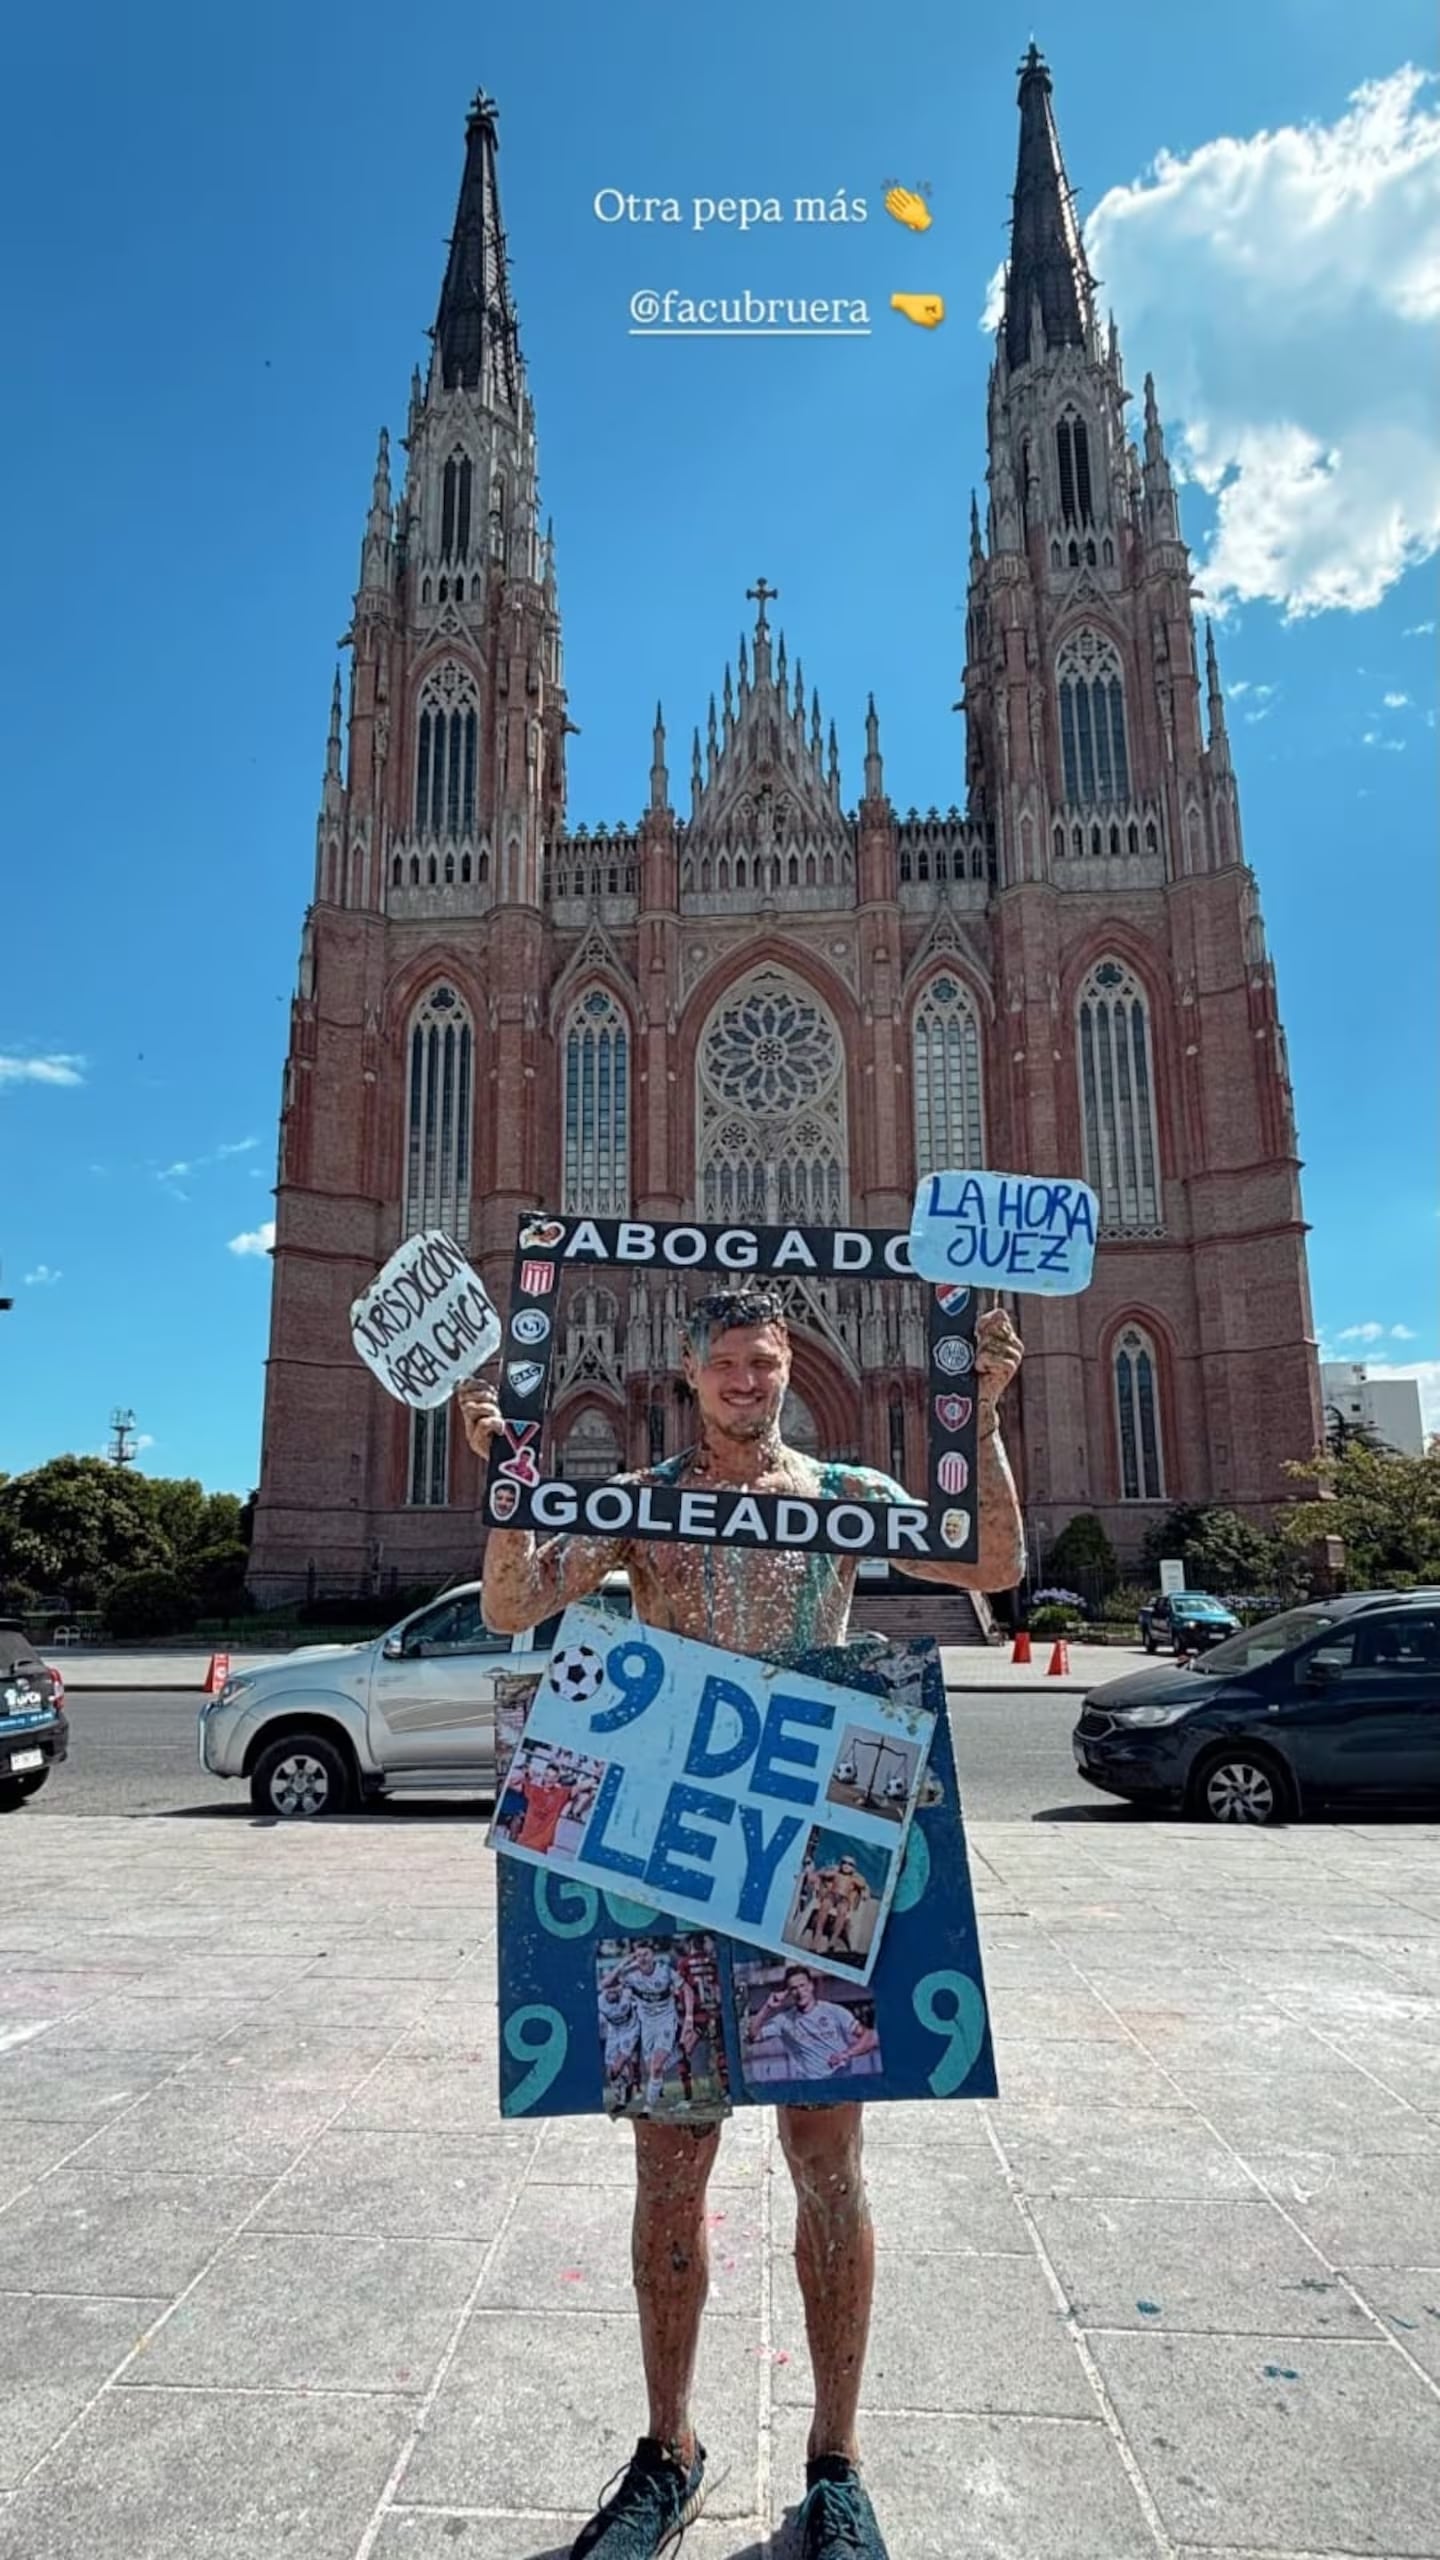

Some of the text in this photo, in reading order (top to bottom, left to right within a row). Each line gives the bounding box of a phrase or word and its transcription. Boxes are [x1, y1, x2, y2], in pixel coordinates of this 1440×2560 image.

[928, 1175, 1095, 1246] LA HORA
[946, 1224, 1070, 1274] JUEZ
[530, 1482, 931, 1551] GOLEADOR
[589, 1641, 836, 1807] 9 DE
[578, 1762, 804, 1925] LEY
[504, 2004, 568, 2118] 9
[912, 1969, 985, 2097] 9
